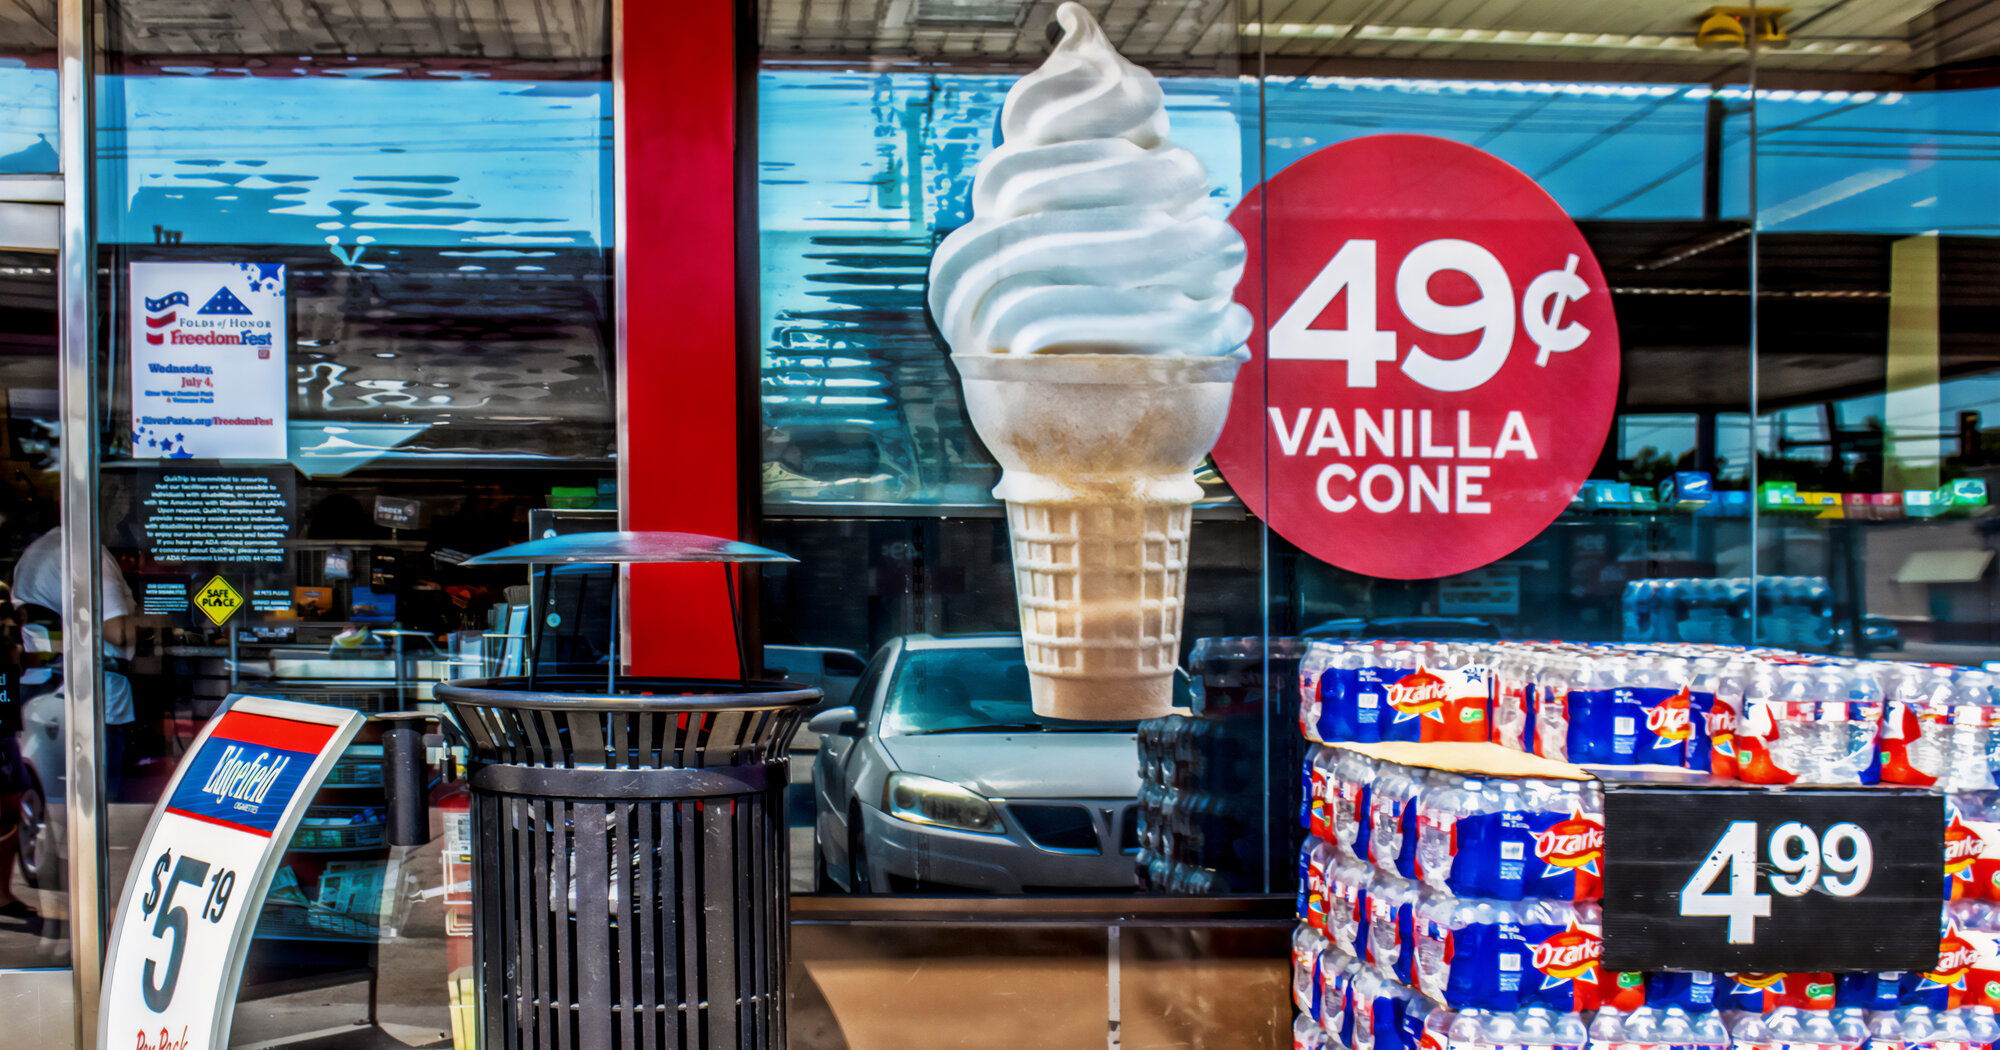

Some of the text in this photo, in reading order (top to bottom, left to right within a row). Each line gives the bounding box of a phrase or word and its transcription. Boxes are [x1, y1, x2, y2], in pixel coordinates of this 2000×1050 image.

[1267, 238, 1591, 392] 49¢
[217, 319, 227, 329] of
[170, 329, 272, 345] FreedomFest
[148, 363, 213, 375] Wednesday,
[181, 377, 213, 388] July 4,
[1267, 406, 1538, 459] VANILLA
[1316, 463, 1491, 514] CONE
[207, 589, 228, 598] SAFE
[202, 745, 290, 804] Edgefield
